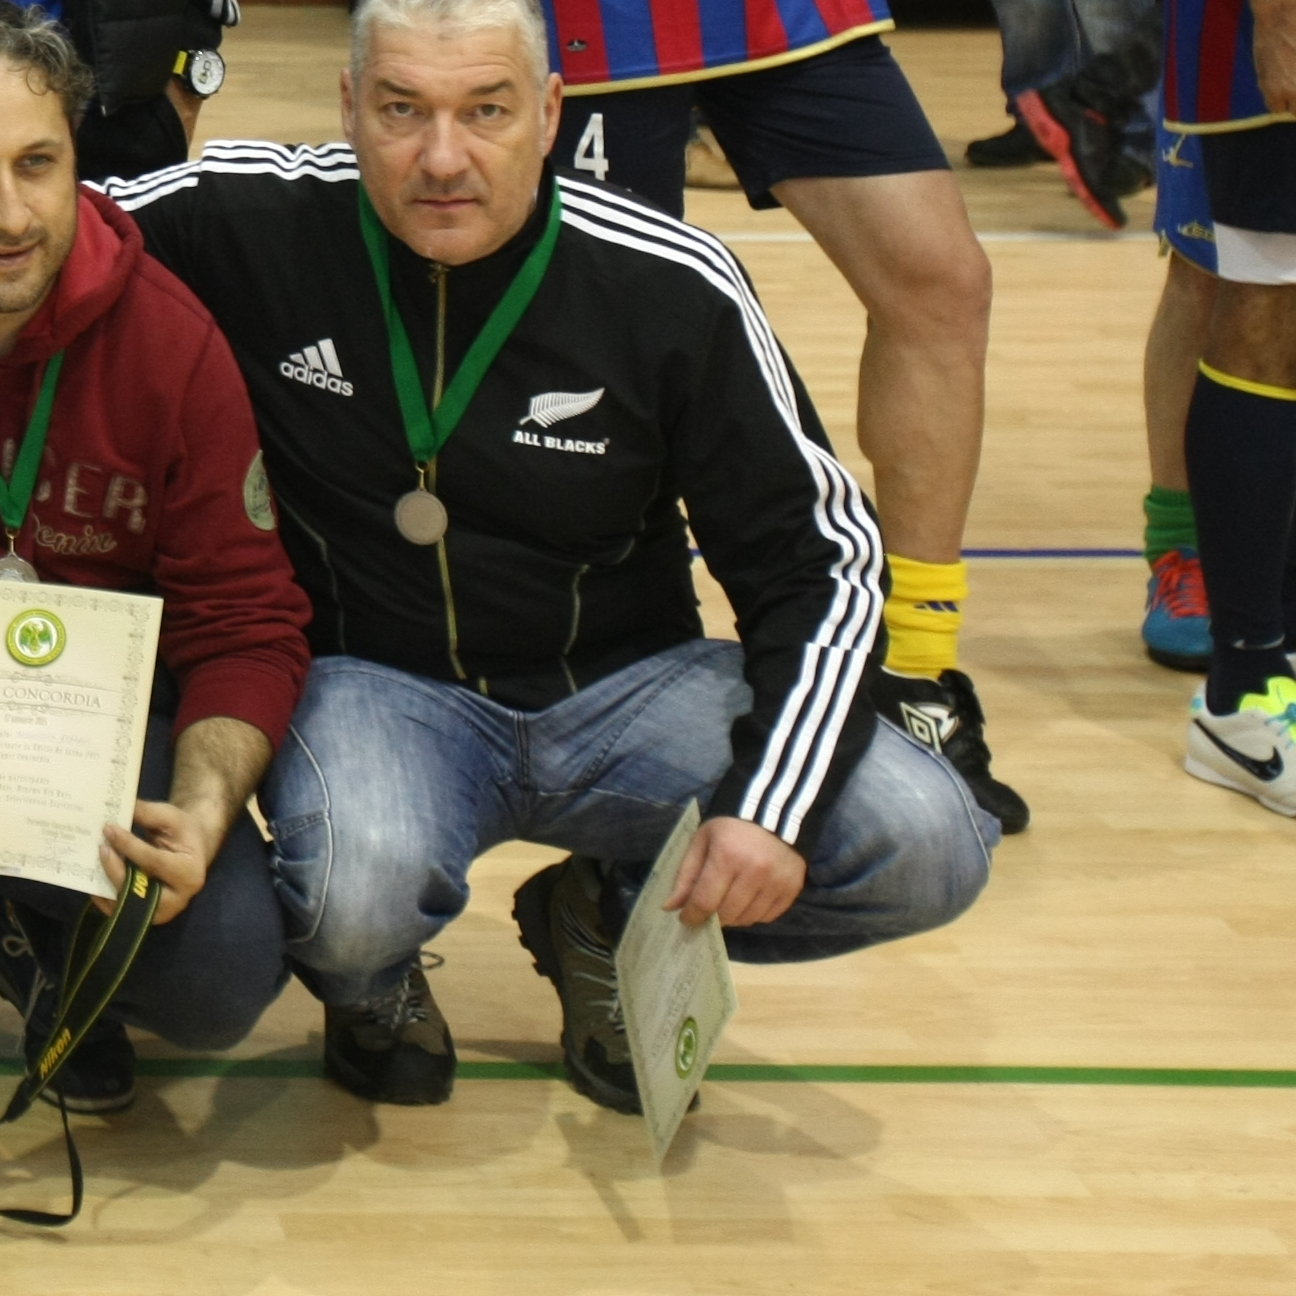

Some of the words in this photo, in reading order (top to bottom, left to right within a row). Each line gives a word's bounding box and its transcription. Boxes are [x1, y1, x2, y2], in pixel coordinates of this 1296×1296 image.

[573, 112, 609, 182] 4
[279, 360, 355, 397] adidas
[512, 429, 542, 447] ALL
[544, 435, 606, 455] BLACKS
[3, 687, 101, 709] CONCORDIA
[40, 1028, 72, 1080] Nikon
